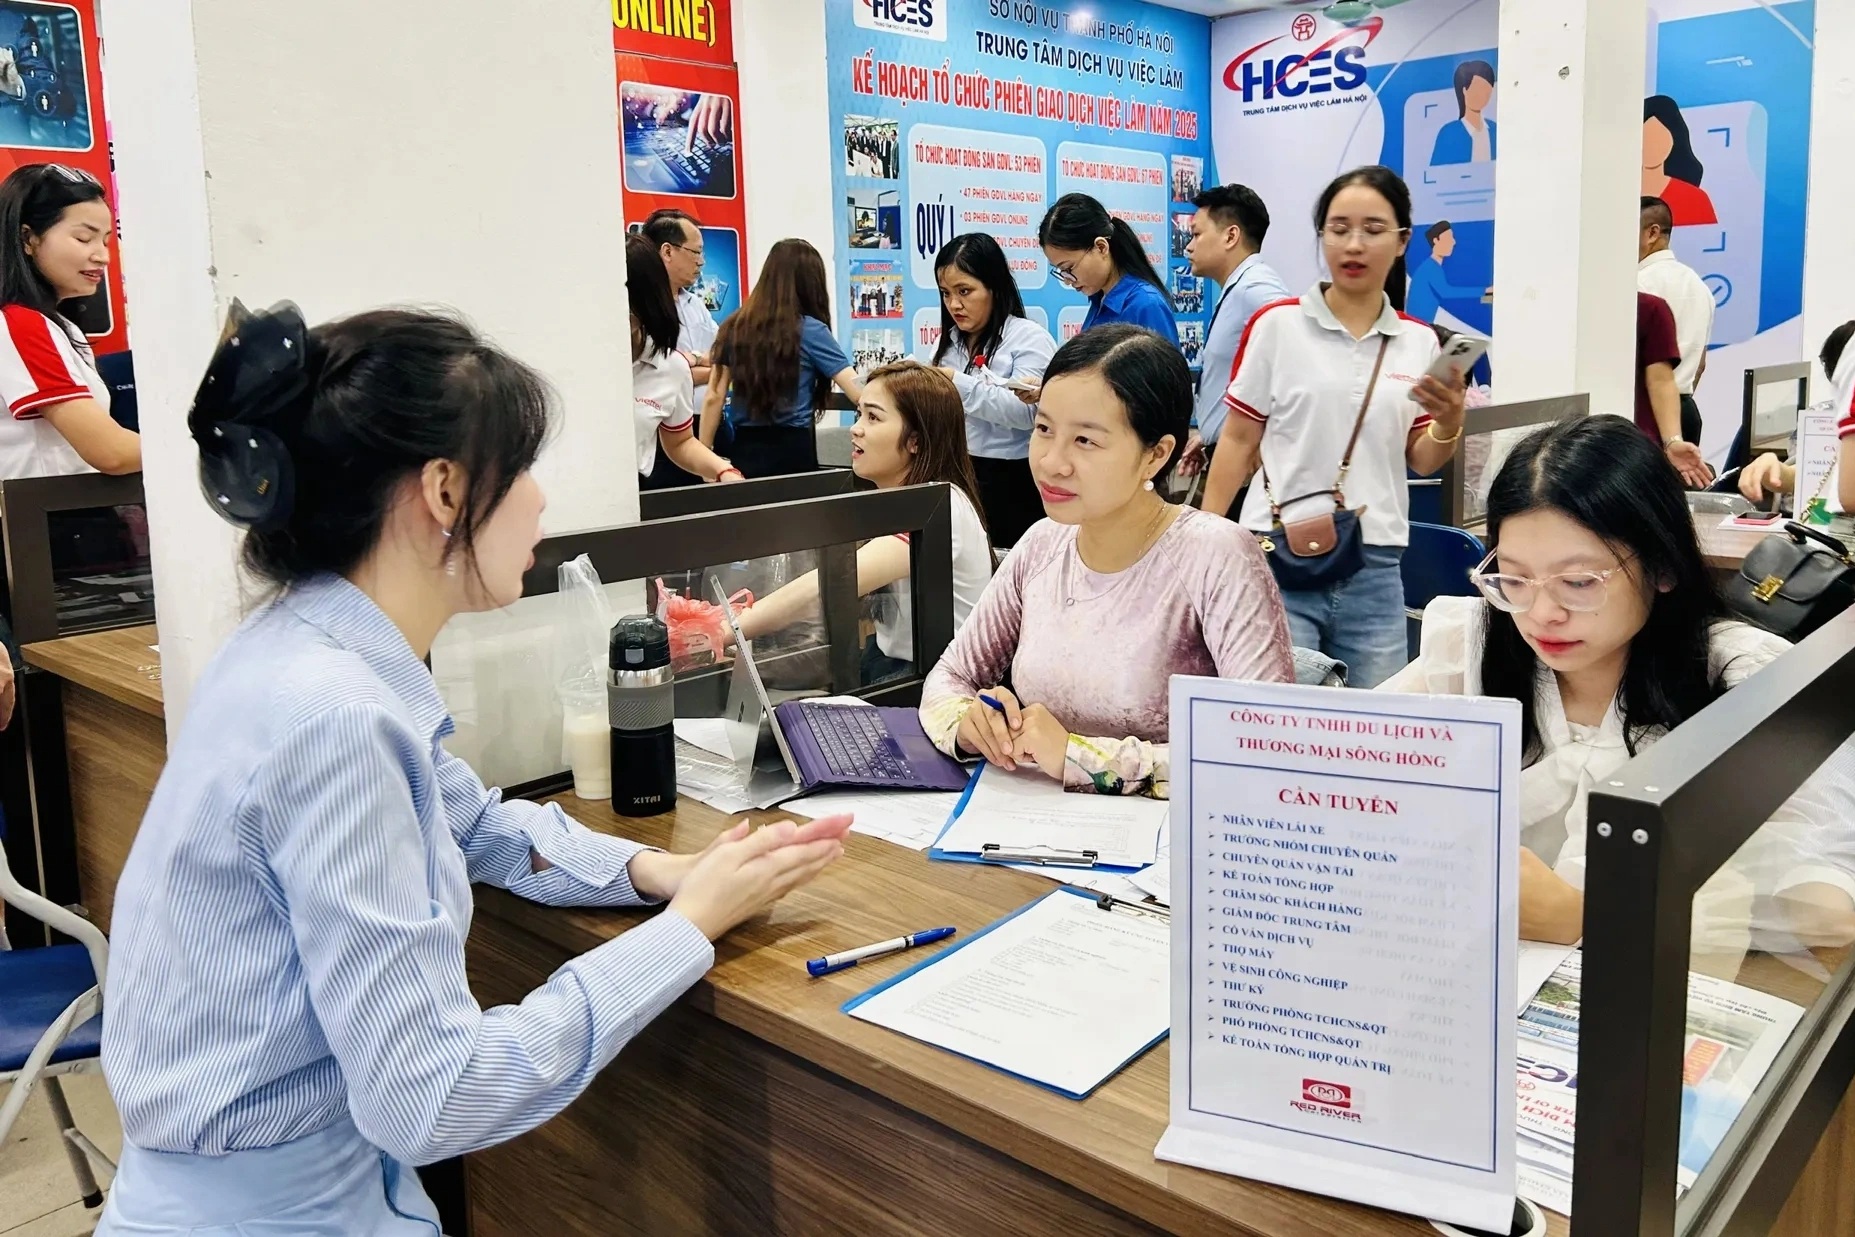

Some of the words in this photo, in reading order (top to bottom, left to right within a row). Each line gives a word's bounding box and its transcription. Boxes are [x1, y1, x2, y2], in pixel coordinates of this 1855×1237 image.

[1014, 0, 1037, 28] NỘI
[1041, 10, 1059, 33] VỤ
[1109, 21, 1134, 45] PHỐ
[1137, 27, 1152, 48] HÀ
[1155, 32, 1175, 56] NỘI
[975, 31, 1028, 61] TRUNG
[1033, 39, 1063, 68] TÂM
[1068, 49, 1102, 76] DỊCH
[1106, 57, 1124, 84] VỤ
[1128, 59, 1156, 88] VIỆC
[1159, 64, 1183, 90] LÀM
[1242, 46, 1367, 102] HCES
[853, 49, 874, 94] KẾ
[878, 62, 928, 106] HOẠCH
[933, 58, 950, 104] TỔ
[954, 70, 990, 110] CHỨC
[994, 77, 1032, 115] PHIÊN
[1037, 87, 1063, 121] GIAO
[1067, 92, 1094, 130] DỊCH
[1098, 92, 1121, 135] VIỆC
[1124, 96, 1146, 132] LÀM
[1149, 101, 1172, 136] NĂM
[1174, 109, 1197, 139] 2025
[1243, 108, 1264, 116] TRUNG
[1266, 105, 1280, 113] TÂM
[1281, 104, 1297, 112] DỊCH
[1309, 100, 1325, 108] VIỆC
[1326, 97, 1341, 106] LÀM
[1342, 95, 1352, 103] HÀ
[1355, 94, 1367, 102] NỘI
[945, 148, 961, 170] HOẠT
[1015, 155, 1022, 172] 53
[964, 189, 971, 197] 47
[916, 194, 945, 260] QUÝ
[1008, 216, 1028, 225] ONLINE
[1230, 708, 1275, 725] CÔNG
[1280, 714, 1300, 727] TY
[1305, 717, 1351, 732] TNHH
[1356, 720, 1378, 734] DU
[1384, 724, 1424, 740] LỊCH
[1429, 725, 1454, 741] VÀ
[1236, 736, 1305, 755] THƯƠNG
[1309, 744, 1341, 761] MẠI
[1345, 745, 1391, 763] SÔNG
[1278, 785, 1321, 807] CẦN
[1326, 794, 1398, 815] TUYỂN
[1222, 814, 1254, 826] NHÂN
[1256, 817, 1284, 830] VIÊN
[1287, 821, 1306, 833] LÁI
[1310, 825, 1325, 835] XE
[1223, 832, 1271, 847] TRƯỞNG
[1273, 840, 1308, 852] NHÓM
[1311, 844, 1360, 859] CHUYÊN
[1222, 851, 1269, 866] CHUYÊN
[1307, 862, 1331, 874] VẬN
[1334, 865, 1354, 877] TẢI
[1241, 872, 1272, 885] TOÁN
[1309, 882, 1334, 894] HỢP
[1222, 888, 1257, 901] CHĂM
[1259, 892, 1281, 905] SÓC
[1284, 897, 1326, 911] KHÁCH
[1328, 902, 1363, 917] HÀNG
[1222, 906, 1252, 919] GIÁM
[1255, 912, 1280, 923] ĐỐC
[1282, 915, 1322, 930] TRUNG
[1324, 920, 1351, 934] TÂM
[1222, 943, 1246, 957] THỢ
[1249, 947, 1275, 960] MÁY
[1267, 931, 1295, 944] DỊCH
[1298, 936, 1314, 949] VỤ
[1222, 961, 1238, 974] VỆ
[1239, 964, 1266, 978] SINH
[1268, 968, 1301, 983] CÔNG
[1303, 975, 1348, 991] NGHIỆP
[1222, 980, 1246, 992] THƯ
[1249, 983, 1264, 995] KÝ
[1222, 998, 1270, 1014] TRƯỞNG
[1272, 1006, 1312, 1021] PHÒNG
[1315, 1013, 1389, 1036] TCHCNS&QT
[1222, 1016, 1245, 1028] PHÓ
[1248, 1020, 1287, 1036] PHÒNG
[1289, 1027, 1362, 1049] TCHCNS&QT
[1240, 1037, 1271, 1051] TOÁN
[1308, 1050, 1333, 1063] HỢP
[1334, 1055, 1369, 1069] QUẢN
[1371, 1060, 1391, 1075] TRỊ
[1290, 1100, 1317, 1112] RED
[1320, 1106, 1361, 1120] RIVER
[1553, 1105, 1575, 1116] TER
